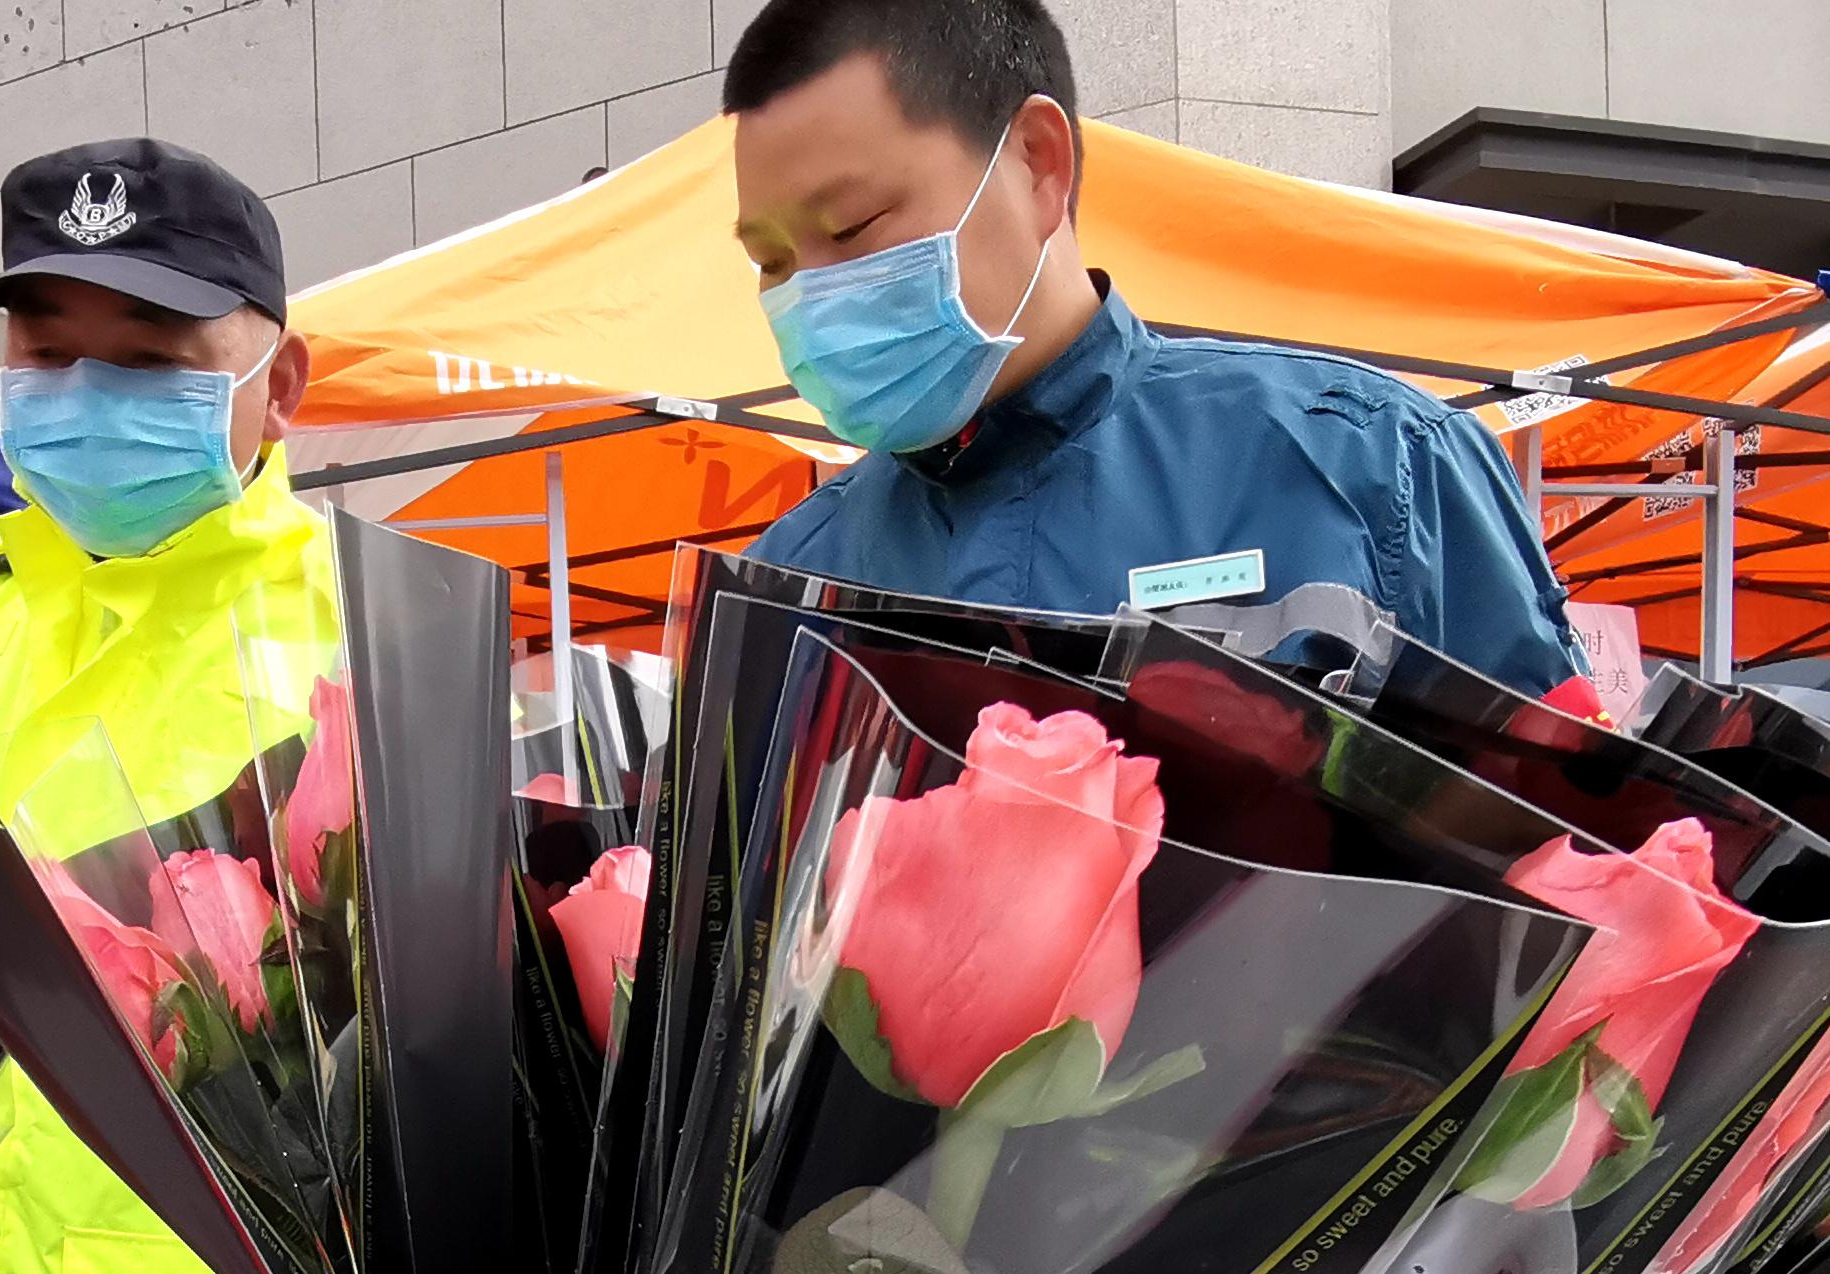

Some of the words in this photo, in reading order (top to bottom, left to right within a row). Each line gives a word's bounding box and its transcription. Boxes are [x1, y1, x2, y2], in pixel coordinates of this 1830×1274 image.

[706, 874, 724, 912] like
[753, 919, 769, 961] like
[1292, 1249, 1319, 1273] so
[1318, 1194, 1377, 1250] sweet
[1373, 1156, 1417, 1198] and
[1624, 1190, 1683, 1248] sweet
[1683, 1147, 1725, 1186] and
